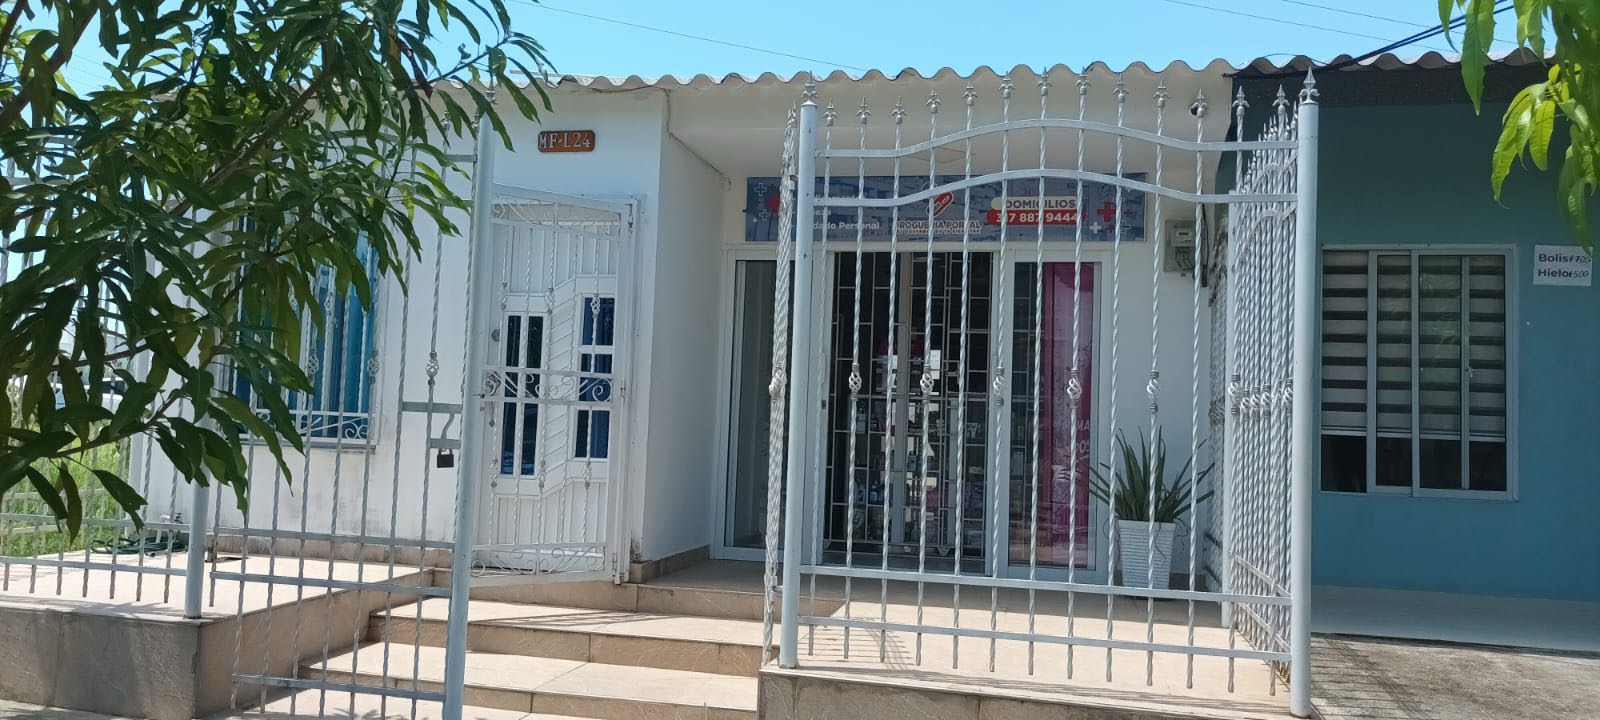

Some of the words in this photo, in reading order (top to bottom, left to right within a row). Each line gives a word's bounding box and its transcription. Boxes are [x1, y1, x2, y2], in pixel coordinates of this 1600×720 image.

[539, 132, 591, 148] MF-L24
[996, 212, 1017, 223] 37
[896, 220, 944, 230] ROGUEIA
[947, 220, 982, 230] PORAL
